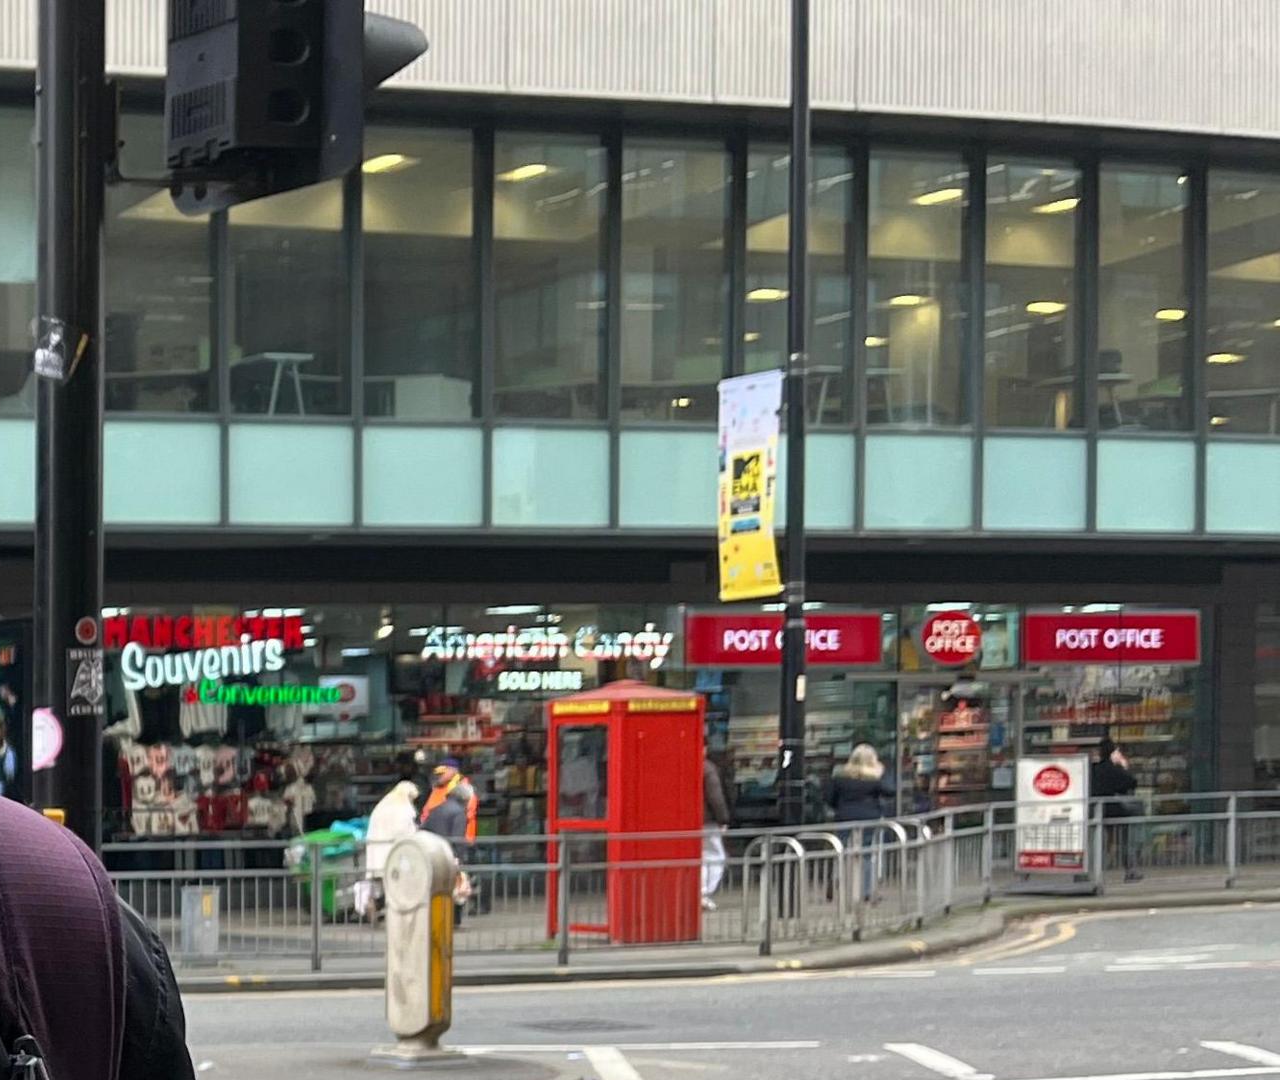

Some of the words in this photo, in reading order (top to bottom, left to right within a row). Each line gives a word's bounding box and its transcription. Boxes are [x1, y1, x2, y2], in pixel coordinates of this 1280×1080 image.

[103, 614, 304, 648] MANCHESTER
[931, 619, 969, 635] POST
[422, 625, 569, 661] American
[574, 622, 674, 669] Candy
[723, 629, 771, 651] POST
[925, 636, 977, 653] OFFICE
[1055, 628, 1101, 650] POST
[1103, 628, 1165, 650] OFFICE
[121, 633, 286, 690] Souvenirs
[199, 678, 340, 705] Convenience
[498, 671, 541, 691] SOLD
[542, 671, 583, 691] HERE
